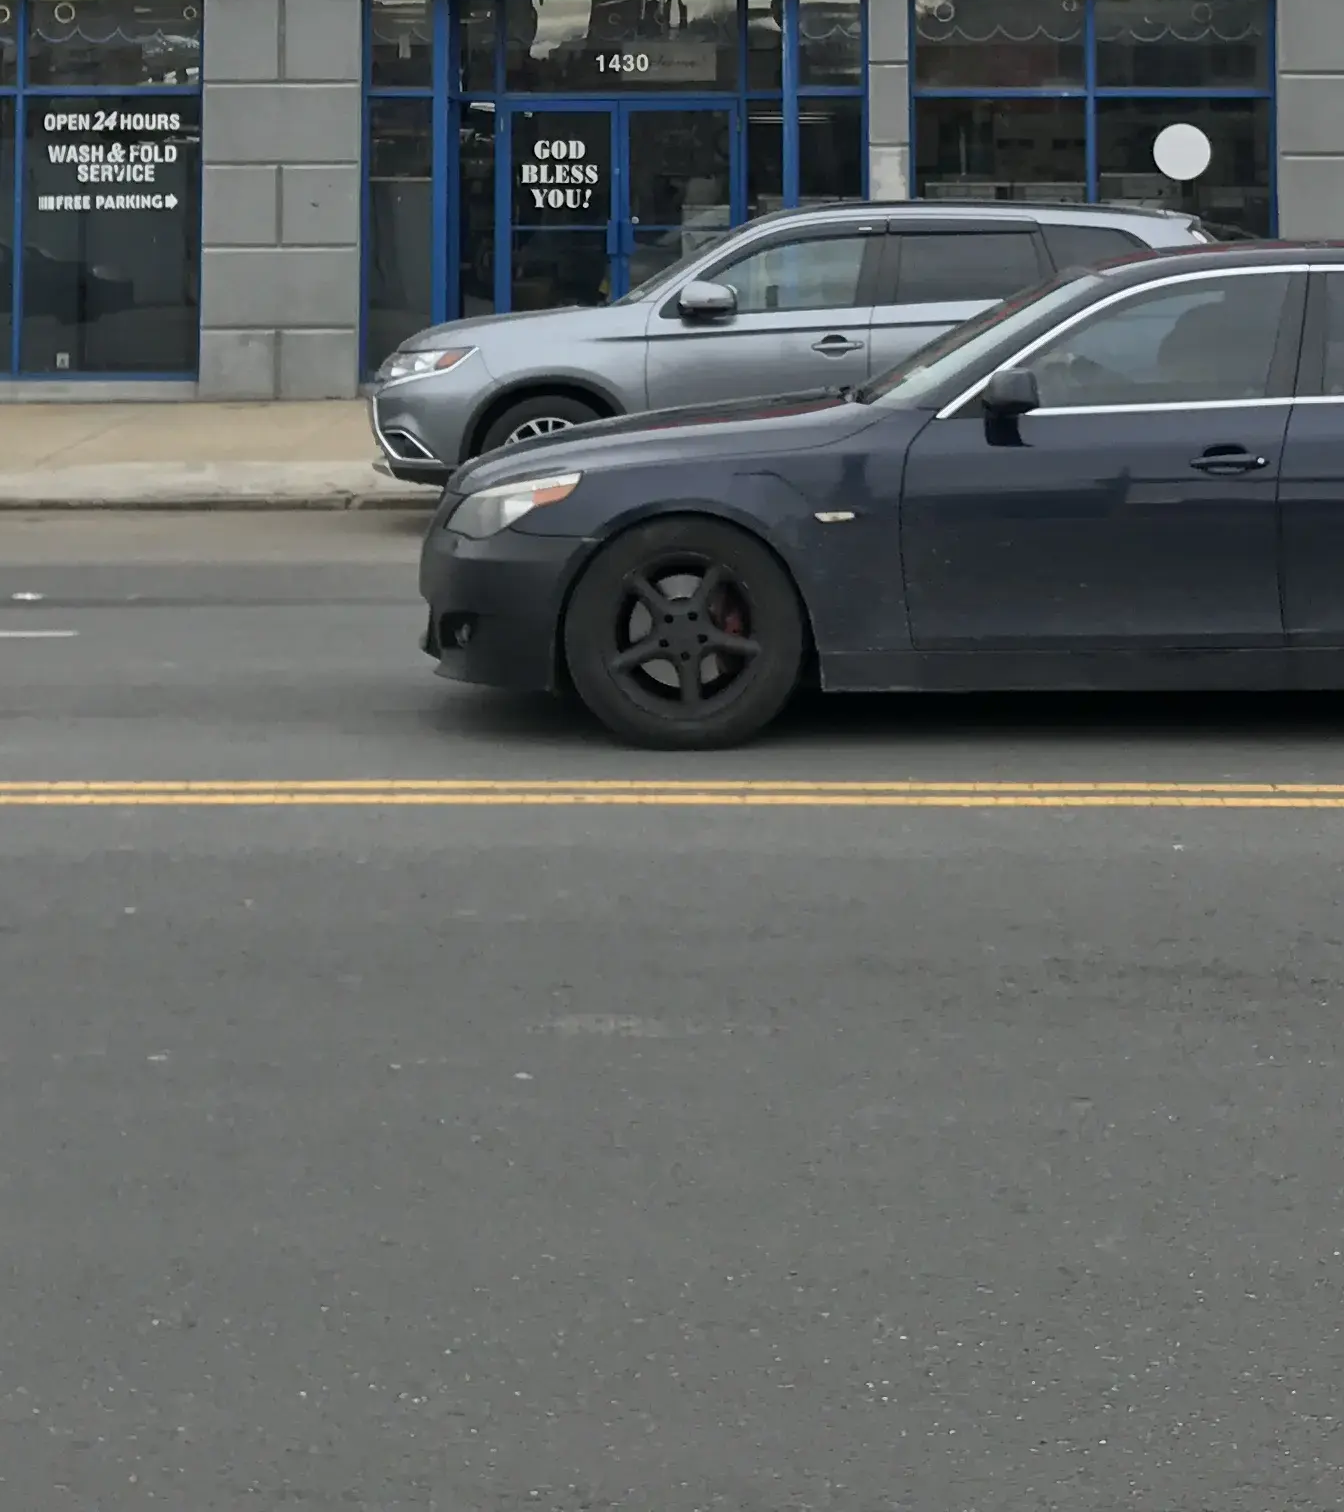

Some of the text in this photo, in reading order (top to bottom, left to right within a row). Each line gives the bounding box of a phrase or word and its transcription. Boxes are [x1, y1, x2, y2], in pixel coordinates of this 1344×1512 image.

[596, 53, 649, 72] 1430
[44, 110, 181, 131] OPEN 24 HOURS
[47, 142, 177, 163] WASH & FOLD
[534, 140, 586, 160] GOD
[77, 164, 156, 183] SERVICE
[521, 164, 599, 184] BLESS
[56, 194, 163, 210] FREE PARKING
[530, 188, 593, 208] YOU!
